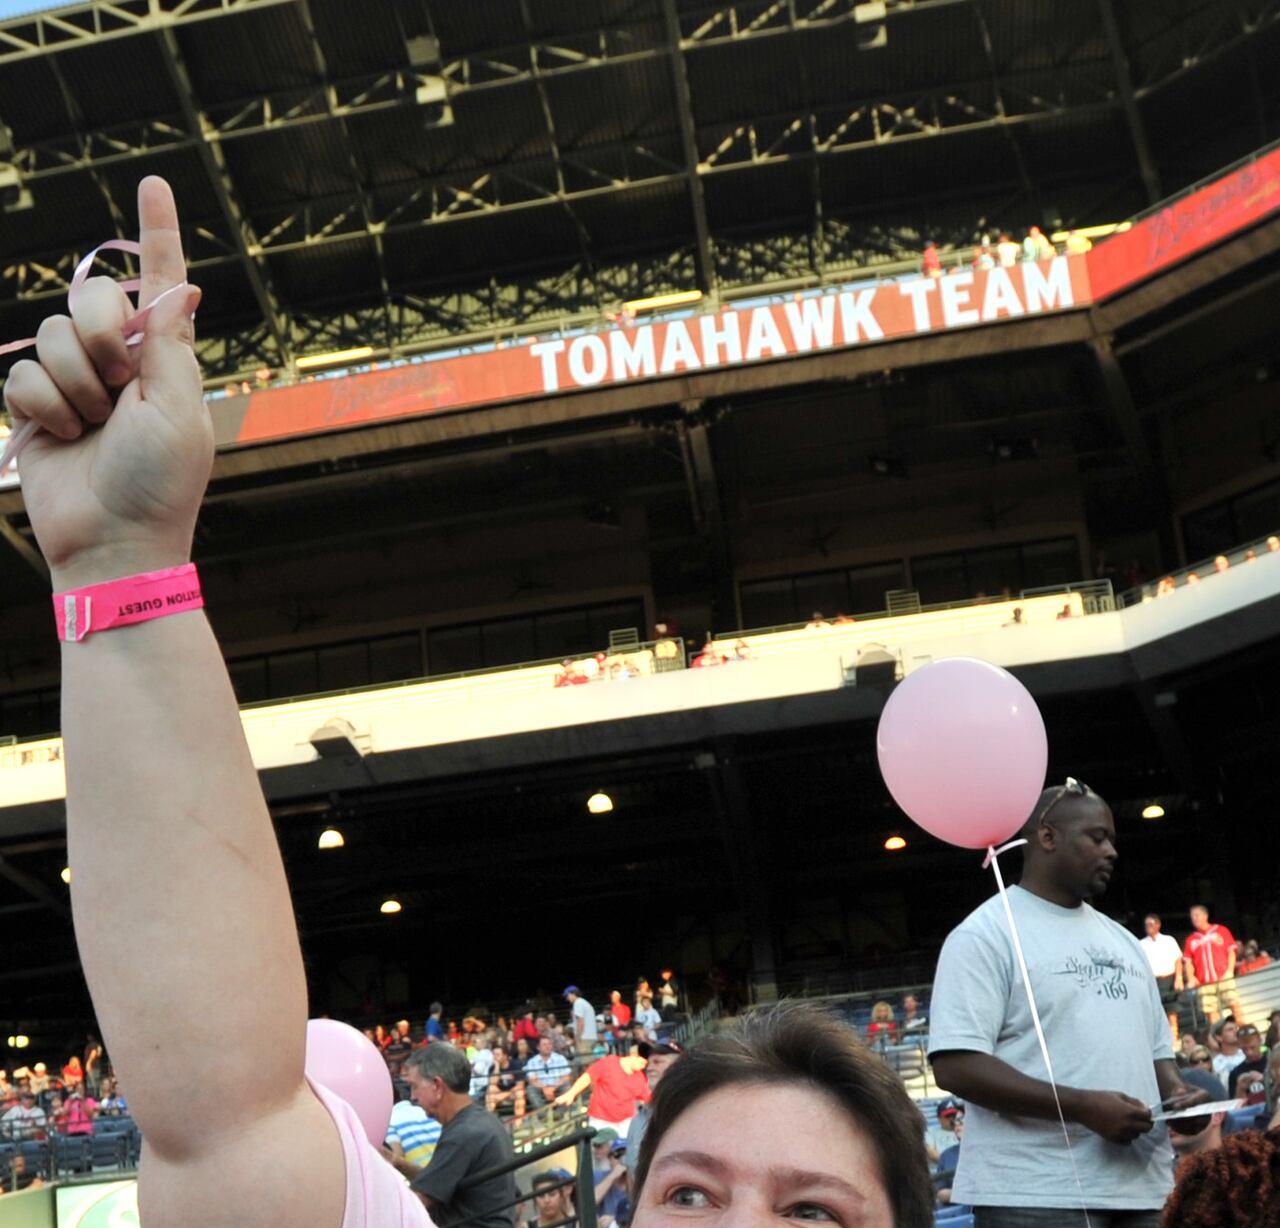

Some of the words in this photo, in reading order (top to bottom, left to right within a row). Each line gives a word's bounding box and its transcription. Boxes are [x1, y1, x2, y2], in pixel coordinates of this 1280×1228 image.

[531, 298, 884, 393] TOMAHAWK
[900, 255, 1075, 333] TEAM
[118, 597, 163, 617] GUEST
